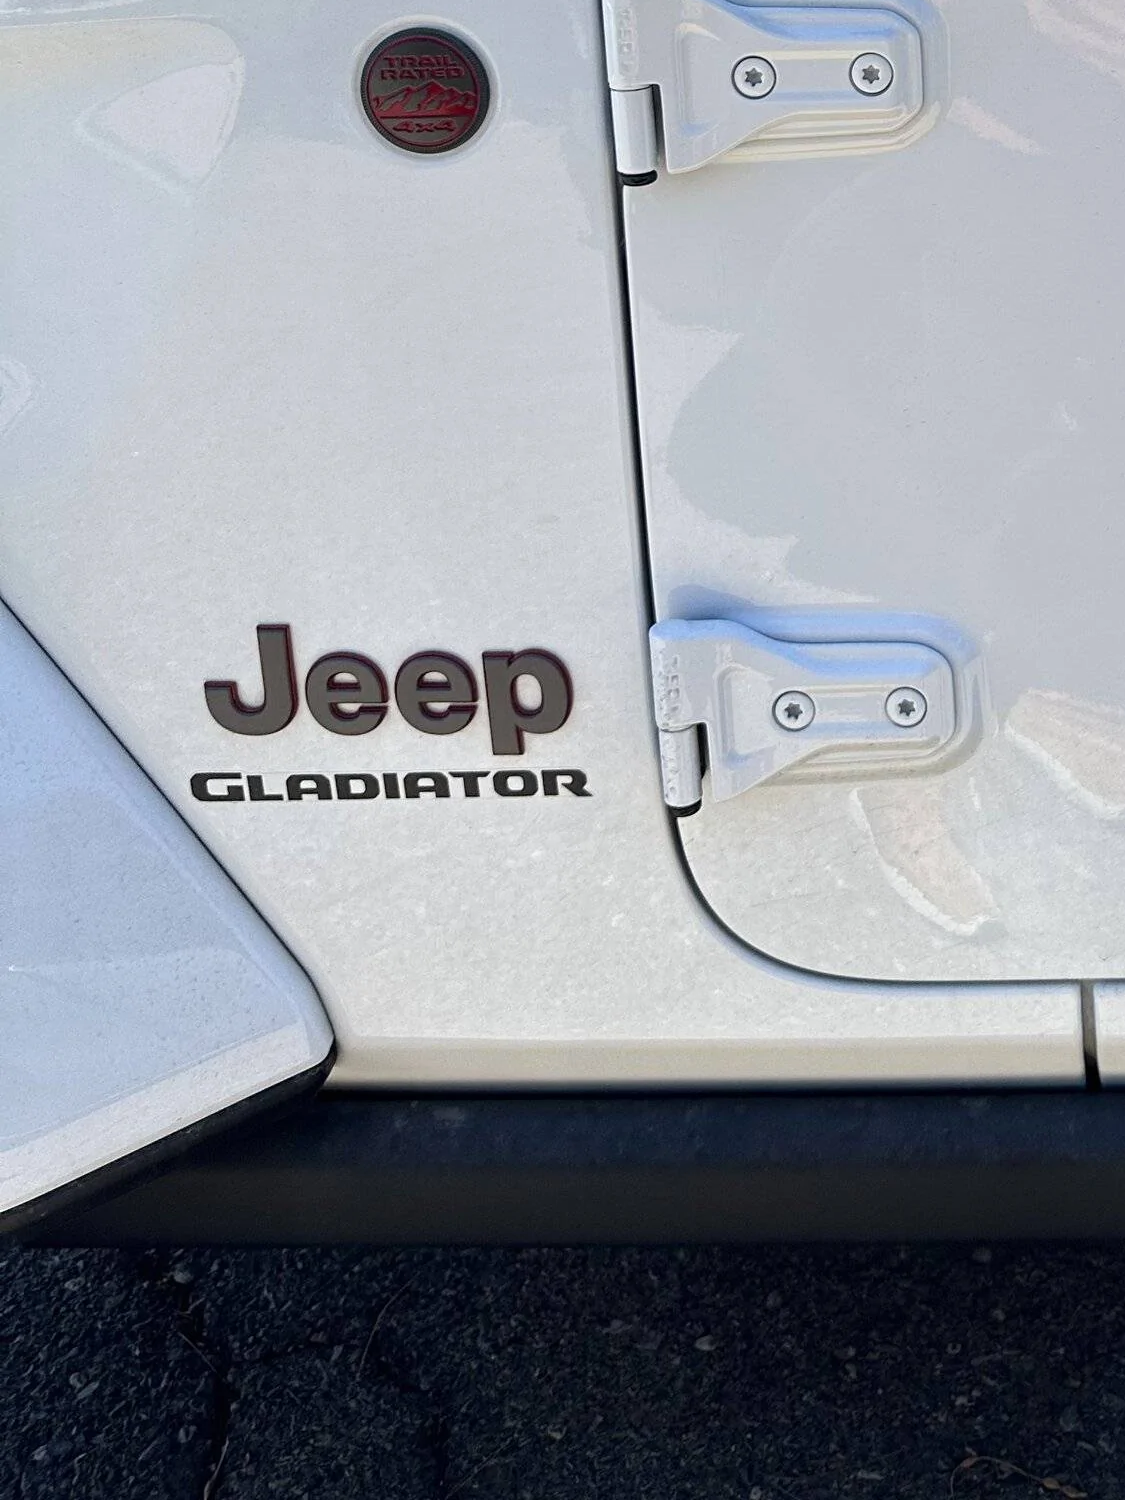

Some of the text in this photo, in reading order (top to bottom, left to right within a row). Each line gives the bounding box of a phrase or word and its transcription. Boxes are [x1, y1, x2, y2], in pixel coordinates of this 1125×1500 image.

[380, 66, 465, 80] RATED
[383, 54, 458, 68] TRAIL
[203, 622, 574, 756] Jeep
[189, 768, 594, 802] GLADIATOR
